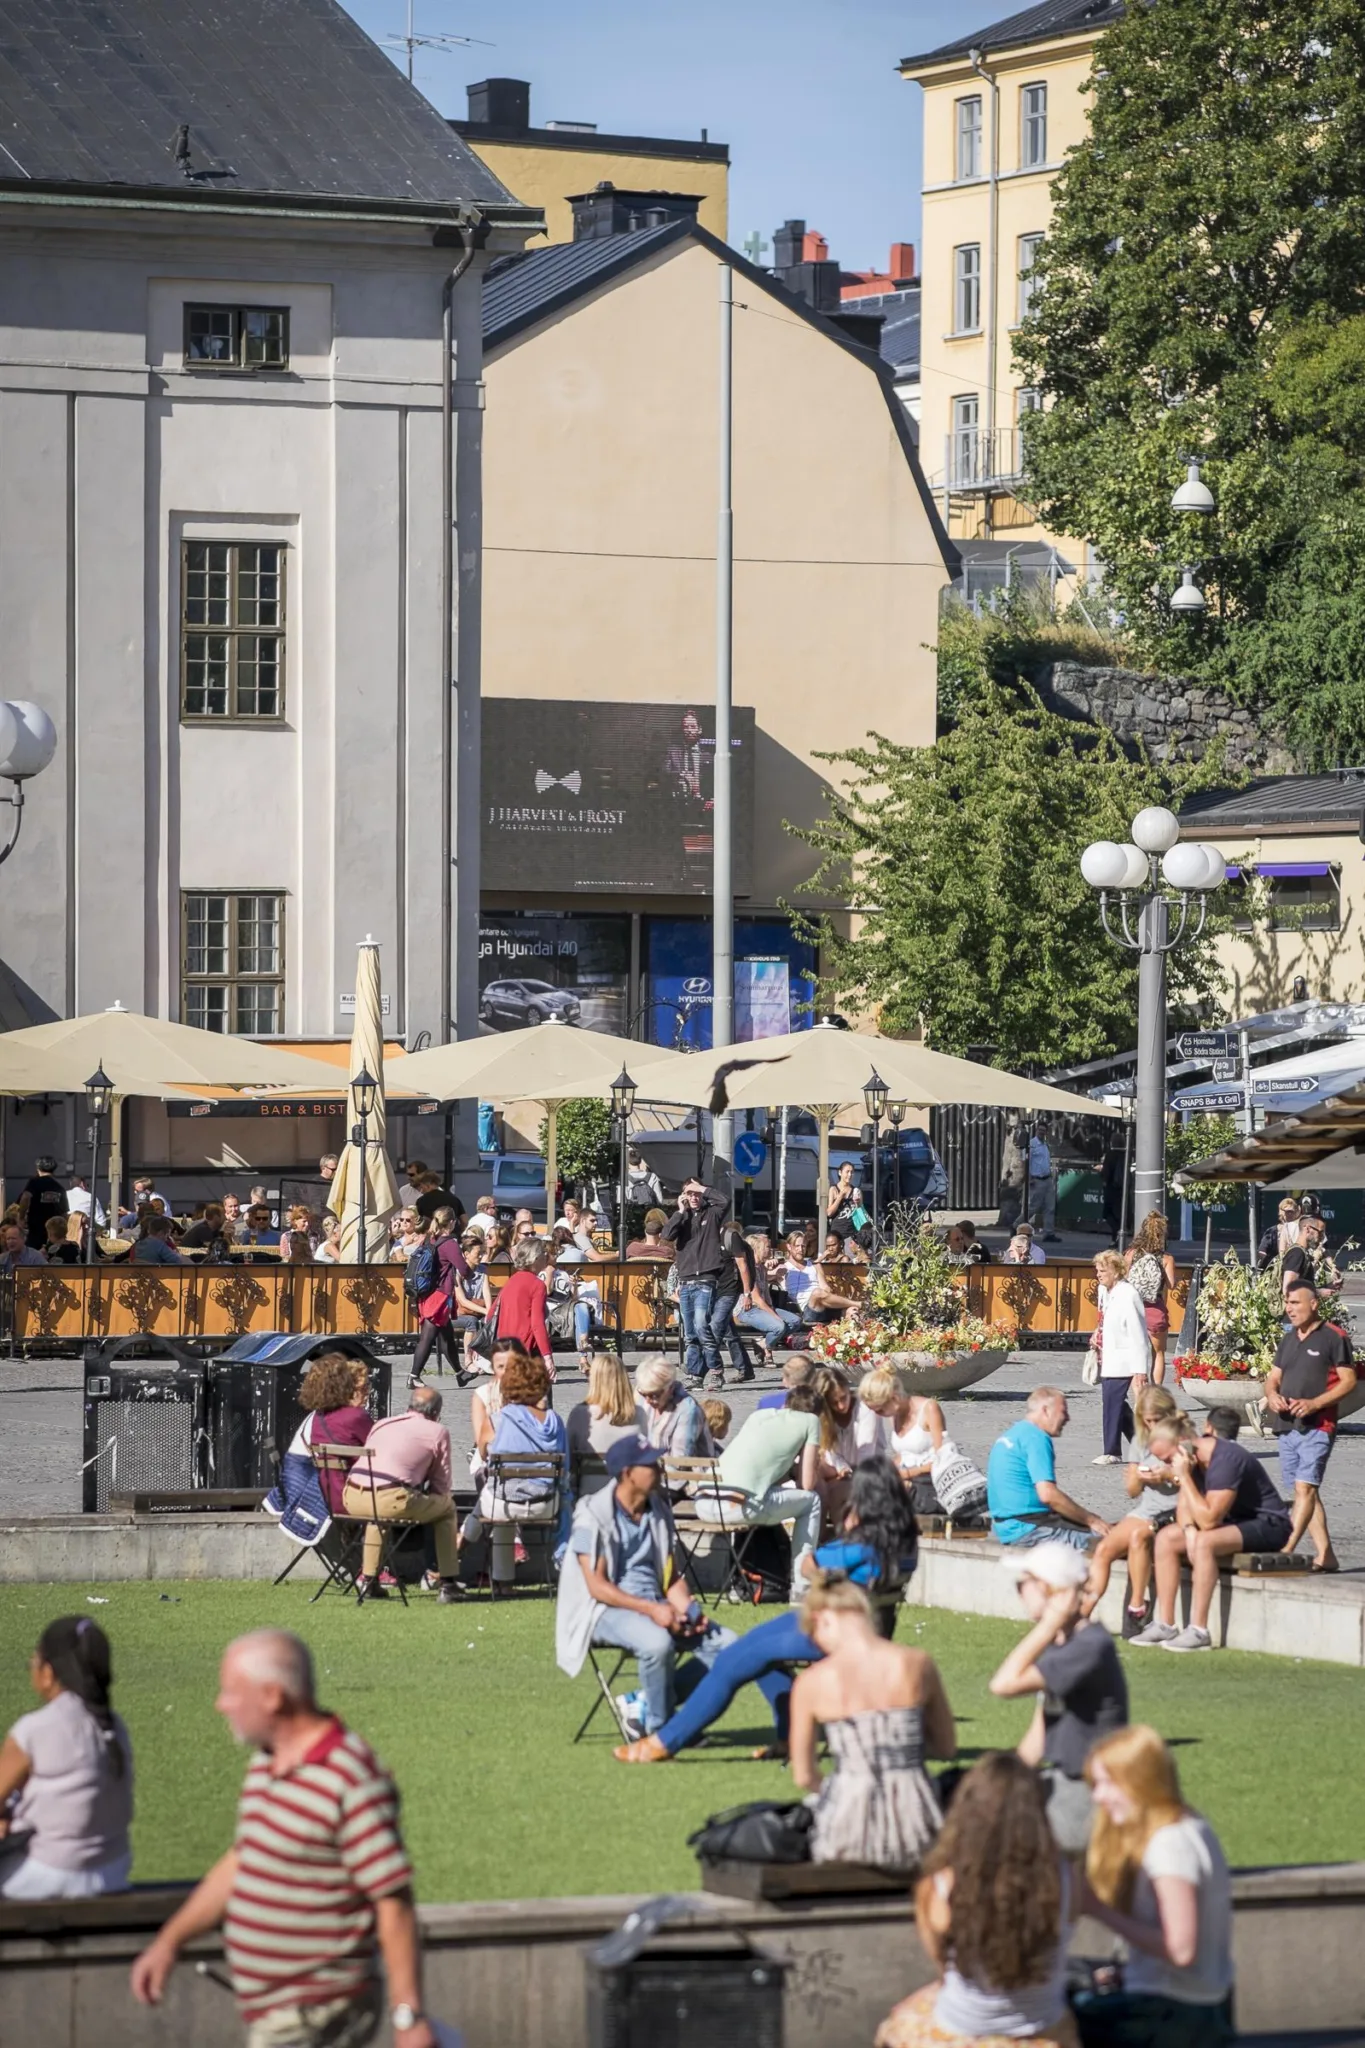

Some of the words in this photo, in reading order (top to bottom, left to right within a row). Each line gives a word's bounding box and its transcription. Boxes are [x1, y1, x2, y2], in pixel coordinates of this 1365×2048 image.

[497, 940, 553, 959] Hyundai
[558, 941, 578, 956] i40
[679, 995, 712, 1003] HYUNDA
[1193, 1037, 1216, 1045] Hornstull
[1193, 1047, 1209, 1055] Södra
[1209, 1047, 1226, 1055] Station
[1271, 1082, 1298, 1090] Skanstull
[1180, 1099, 1204, 1108] SNAPS
[1218, 1096, 1223, 1104] &
[1225, 1095, 1238, 1104] Grill
[260, 1104, 291, 1115] BAR
[298, 1104, 307, 1114] &
[313, 1104, 346, 1114] BIST
[1321, 1209, 1335, 1219] DEN
